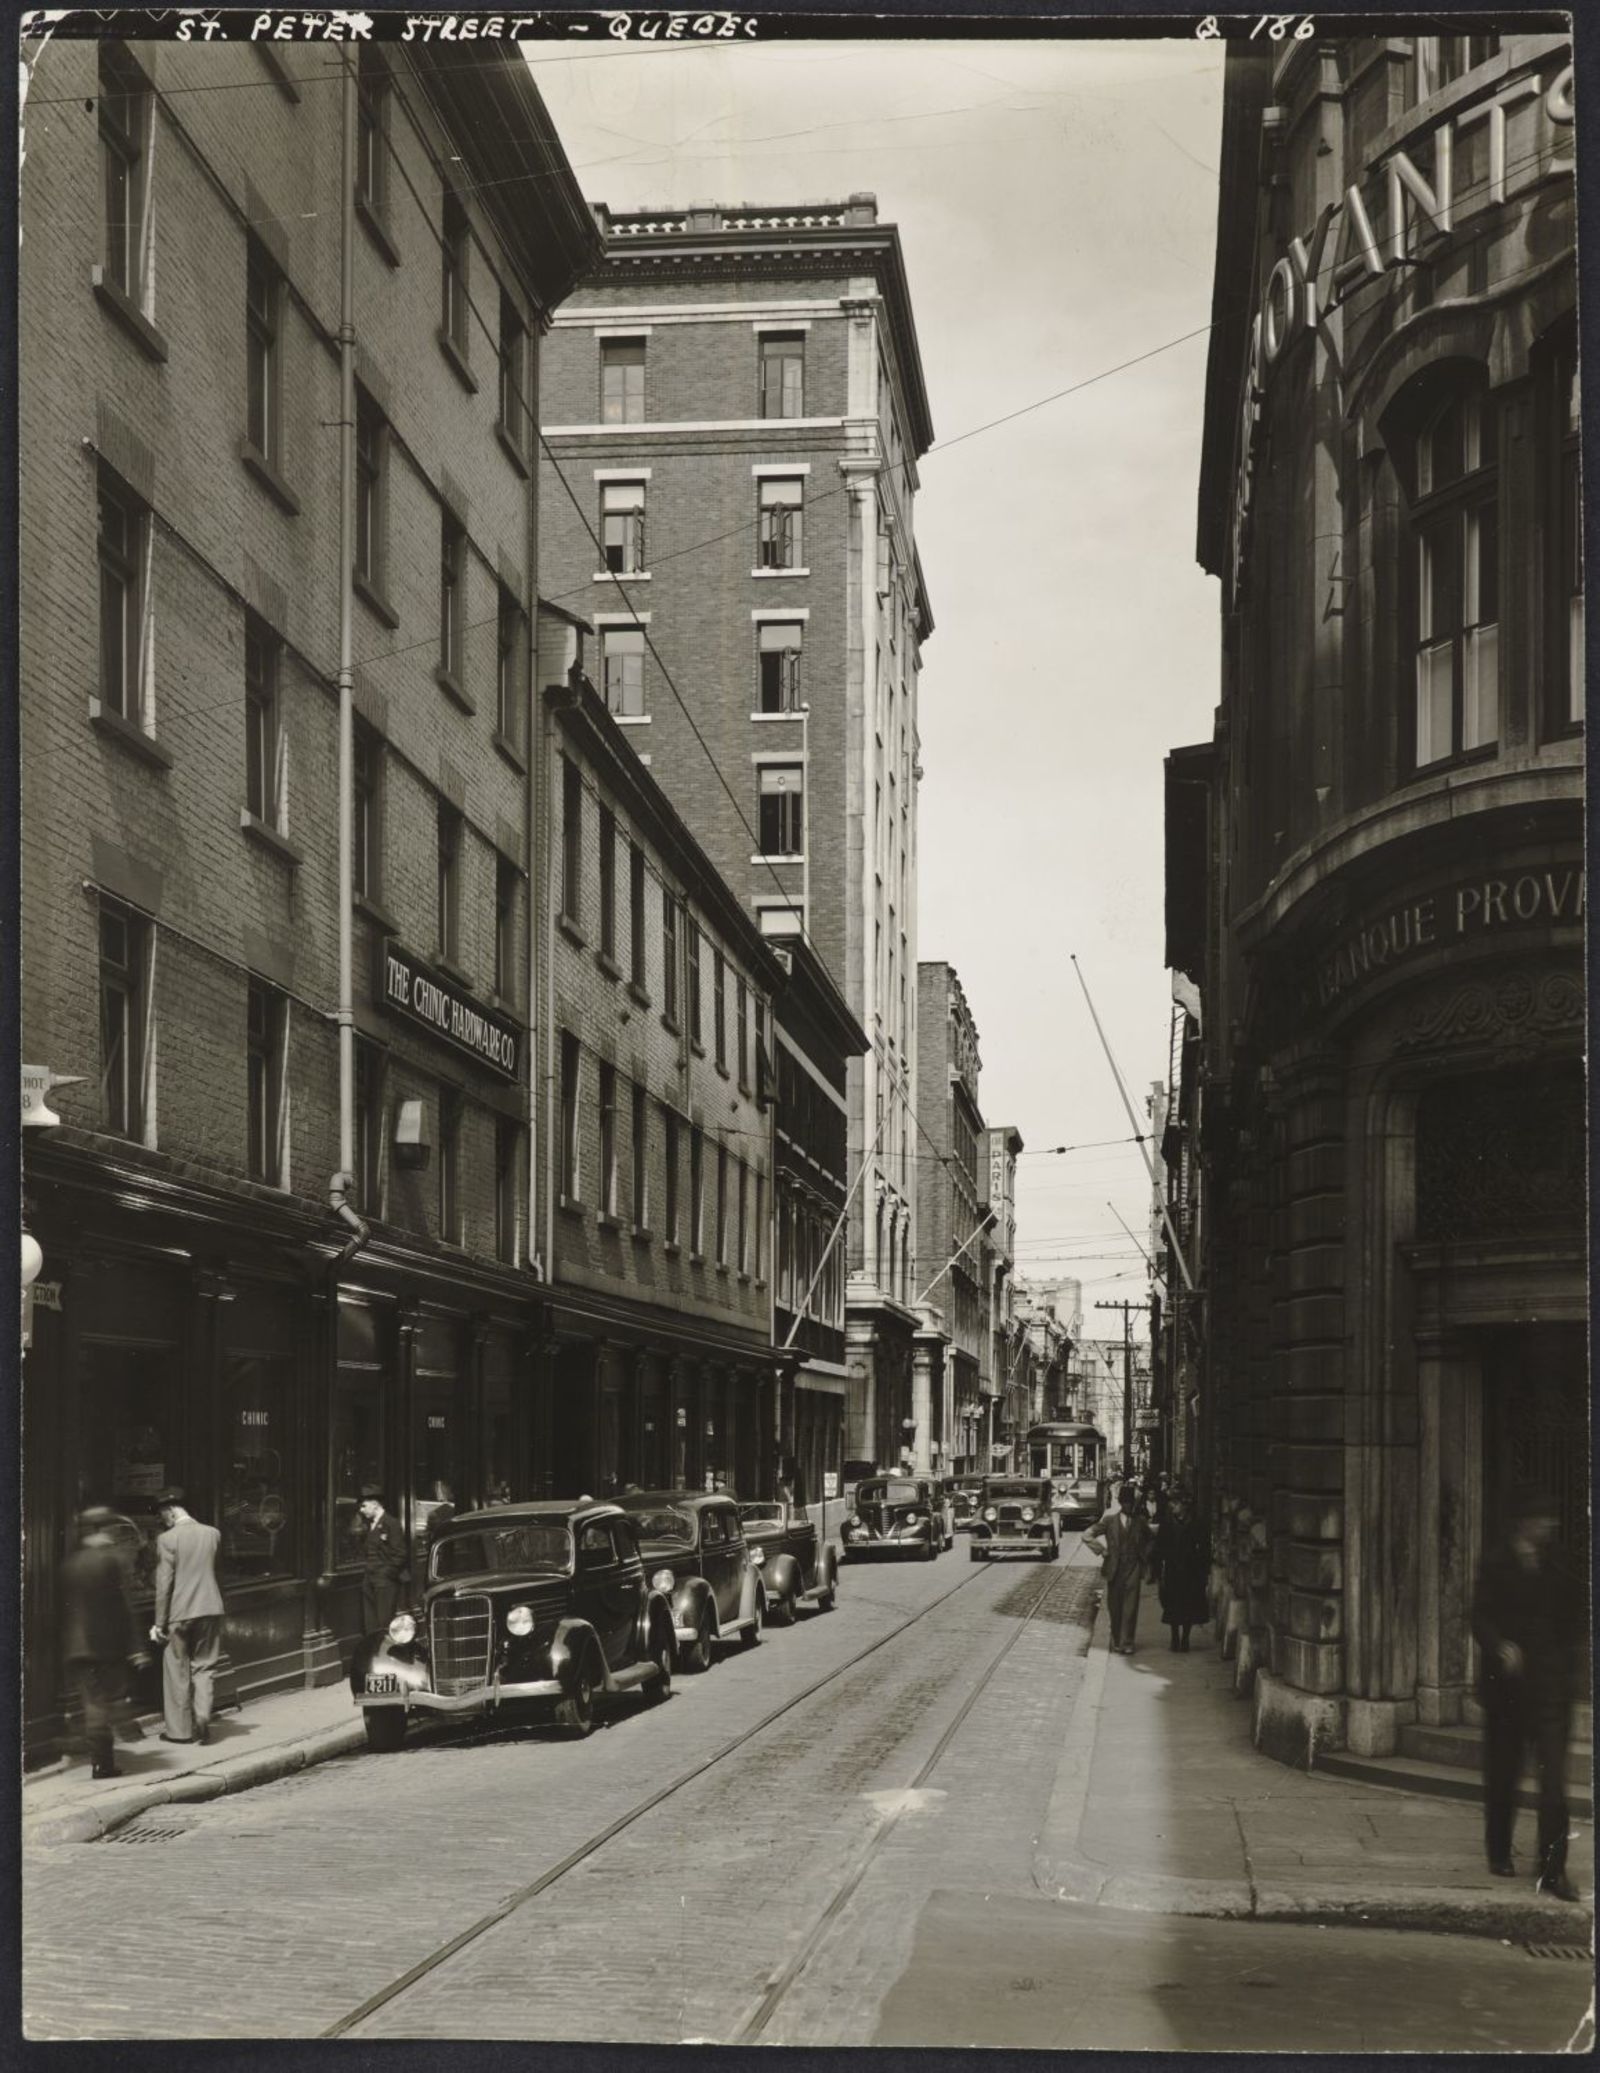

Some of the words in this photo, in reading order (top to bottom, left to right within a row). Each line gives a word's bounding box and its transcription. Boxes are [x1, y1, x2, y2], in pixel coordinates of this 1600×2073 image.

[387, 956, 410, 1006] THE
[413, 976, 450, 1030] CHINIC
[450, 999, 501, 1063] HARDWARE
[501, 1033, 515, 1071] CO
[991, 1150, 1001, 1202] PARIS
